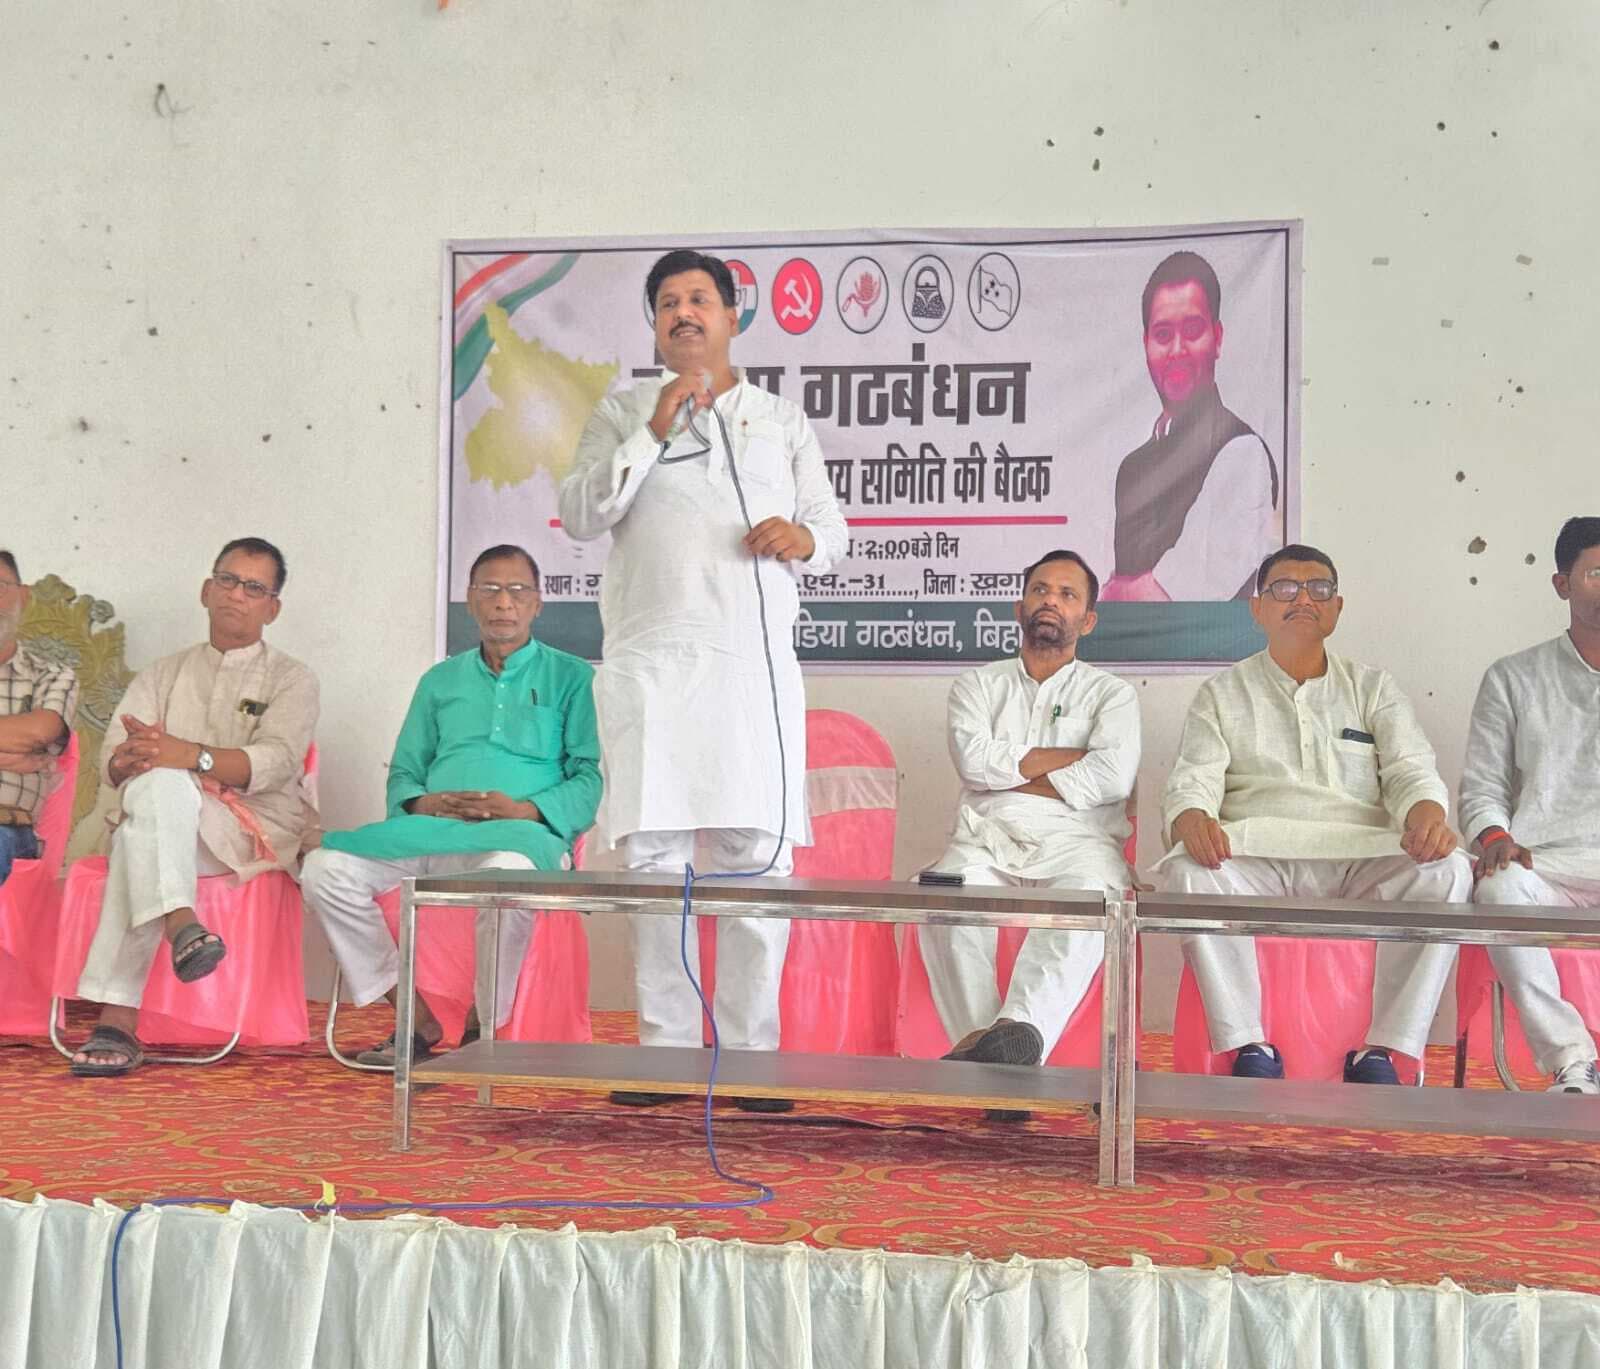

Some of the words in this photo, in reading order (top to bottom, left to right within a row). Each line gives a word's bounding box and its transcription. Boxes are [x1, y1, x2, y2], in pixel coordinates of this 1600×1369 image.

[800, 342, 1031, 427] गठबंधन
[861, 442, 946, 504] समिति
[954, 442, 987, 503] की
[994, 442, 1052, 503] बैठक
[936, 532, 960, 558] दिन
[544, 575, 574, 595] स्थान
[923, 568, 957, 595] जिला
[855, 608, 963, 653] गठबंधन,
[973, 607, 1023, 654] बिहा
